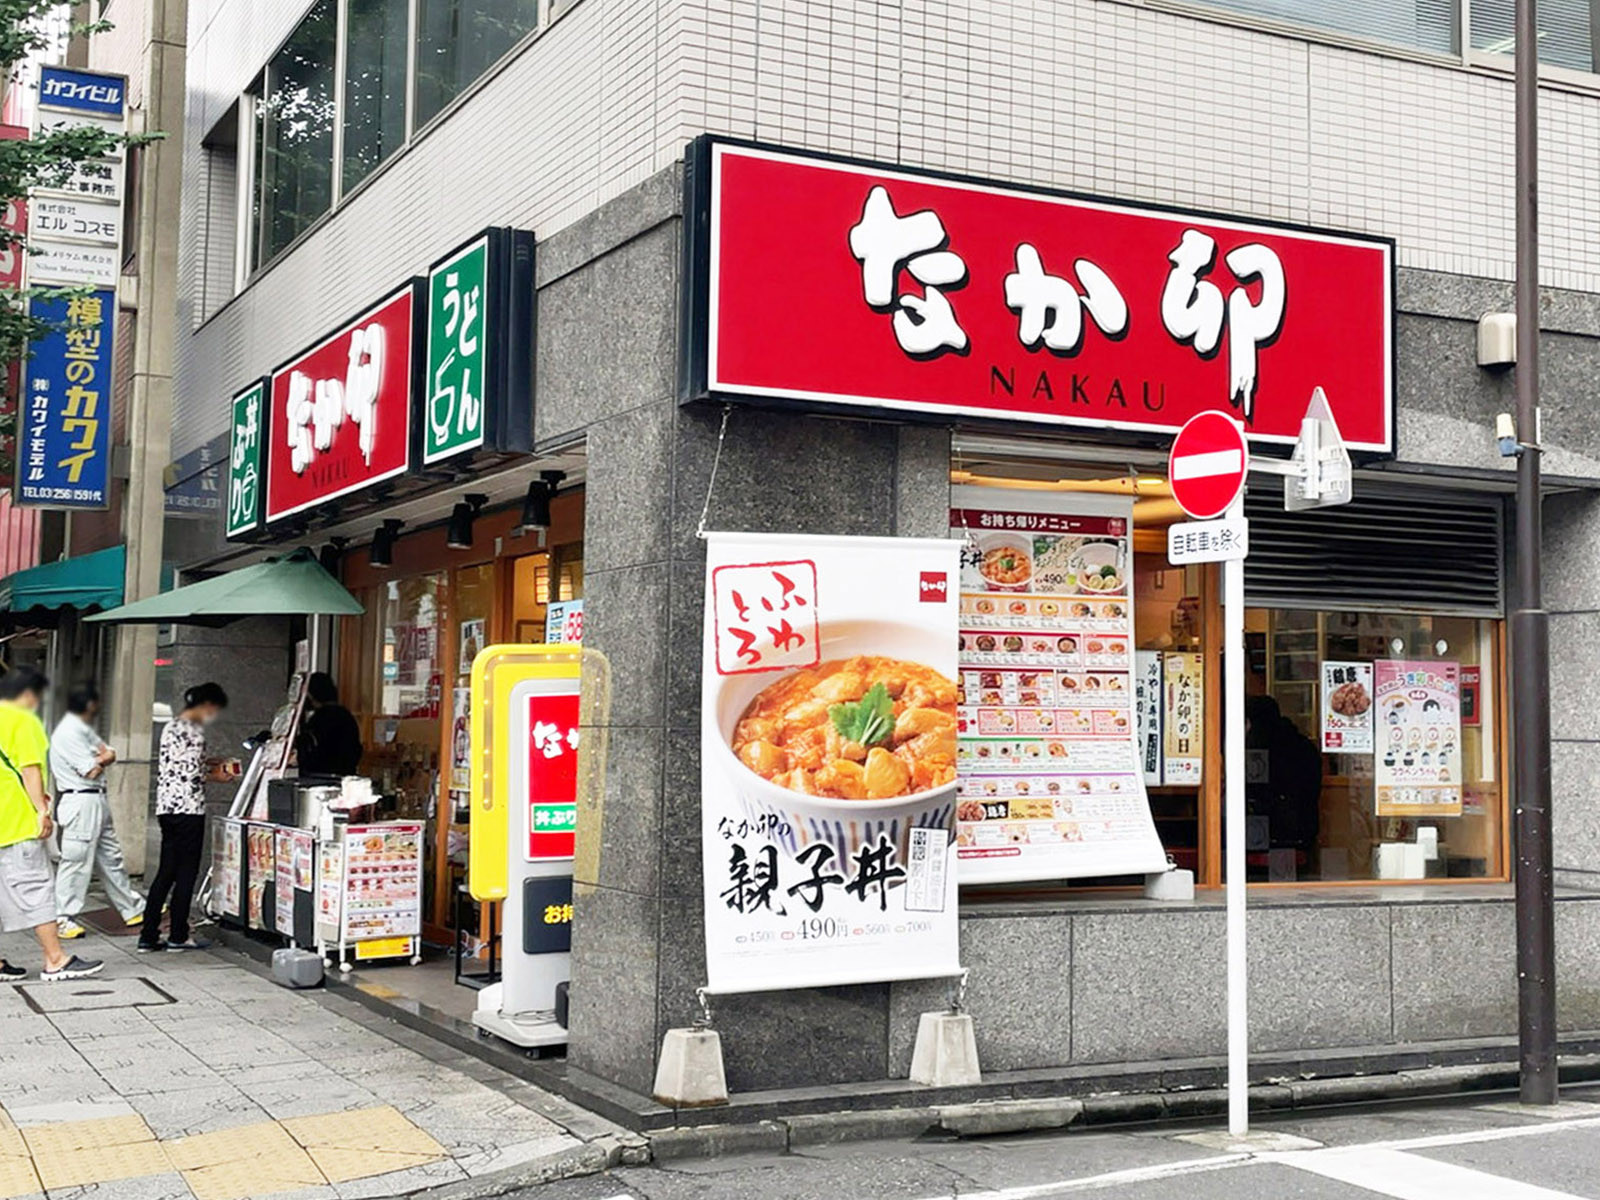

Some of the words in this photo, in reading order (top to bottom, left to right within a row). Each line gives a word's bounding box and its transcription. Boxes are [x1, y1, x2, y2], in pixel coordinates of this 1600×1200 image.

[43, 78, 121, 104] カワイビル
[37, 203, 76, 215] 株式会社
[36, 215, 68, 230] エル
[73, 219, 116, 237] コスモ
[848, 184, 1288, 424] なか卯
[442, 271, 480, 436] うどん
[57, 296, 104, 483] 模型のカワイ
[990, 364, 1167, 412] NAKAU
[980, 513, 1082, 530] お持ち帰りメニュー
[1173, 528, 1242, 556] 自転車を除く
[535, 810, 577, 826] 丼ぶり
[717, 813, 792, 841] なか卯の
[719, 835, 906, 917] 親子丼
[797, 916, 849, 940] 490円
